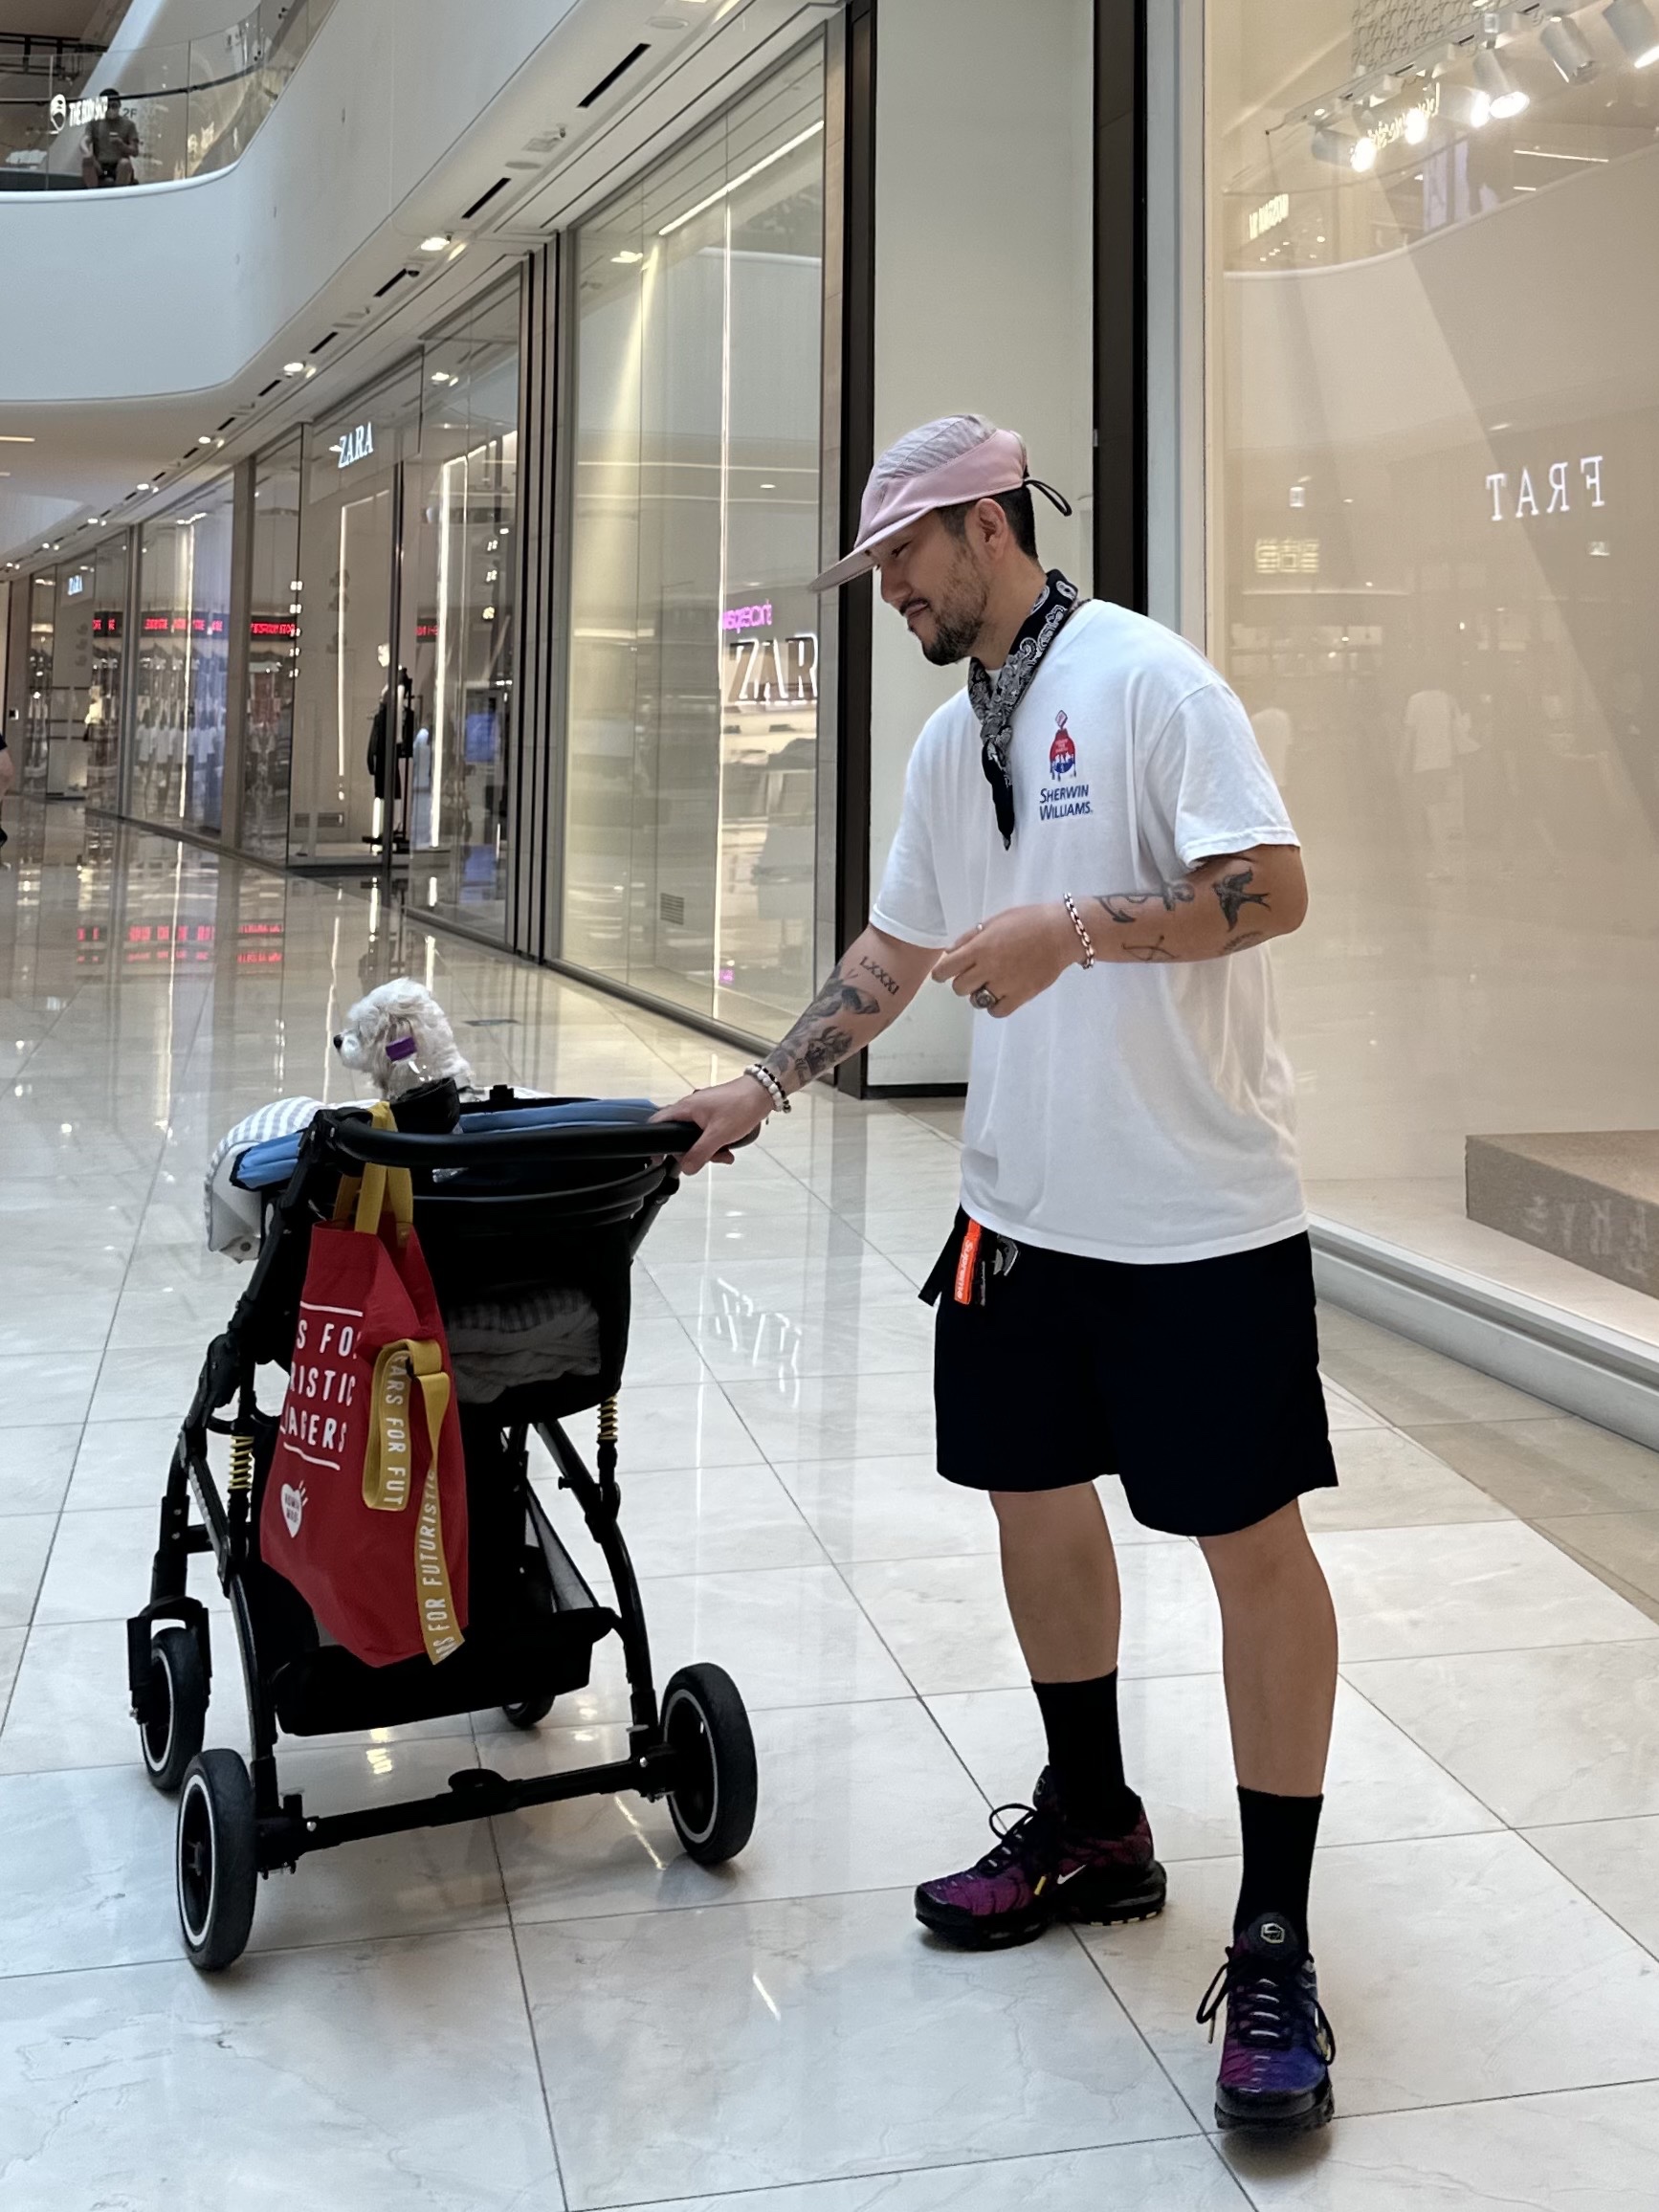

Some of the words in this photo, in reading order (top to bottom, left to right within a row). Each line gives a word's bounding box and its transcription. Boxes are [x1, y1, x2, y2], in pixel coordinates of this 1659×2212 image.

[122, 107, 138, 120] 2F
[338, 421, 374, 468] ZARA
[1040, 785, 1089, 804] SHERWIN
[859, 956, 900, 995] LXXXI
[386, 1417, 407, 1452] FOR
[384, 1467, 406, 1505] FUT
[419, 1469, 443, 1586] FUTURISTIC
[425, 1598, 451, 1632] FOR
